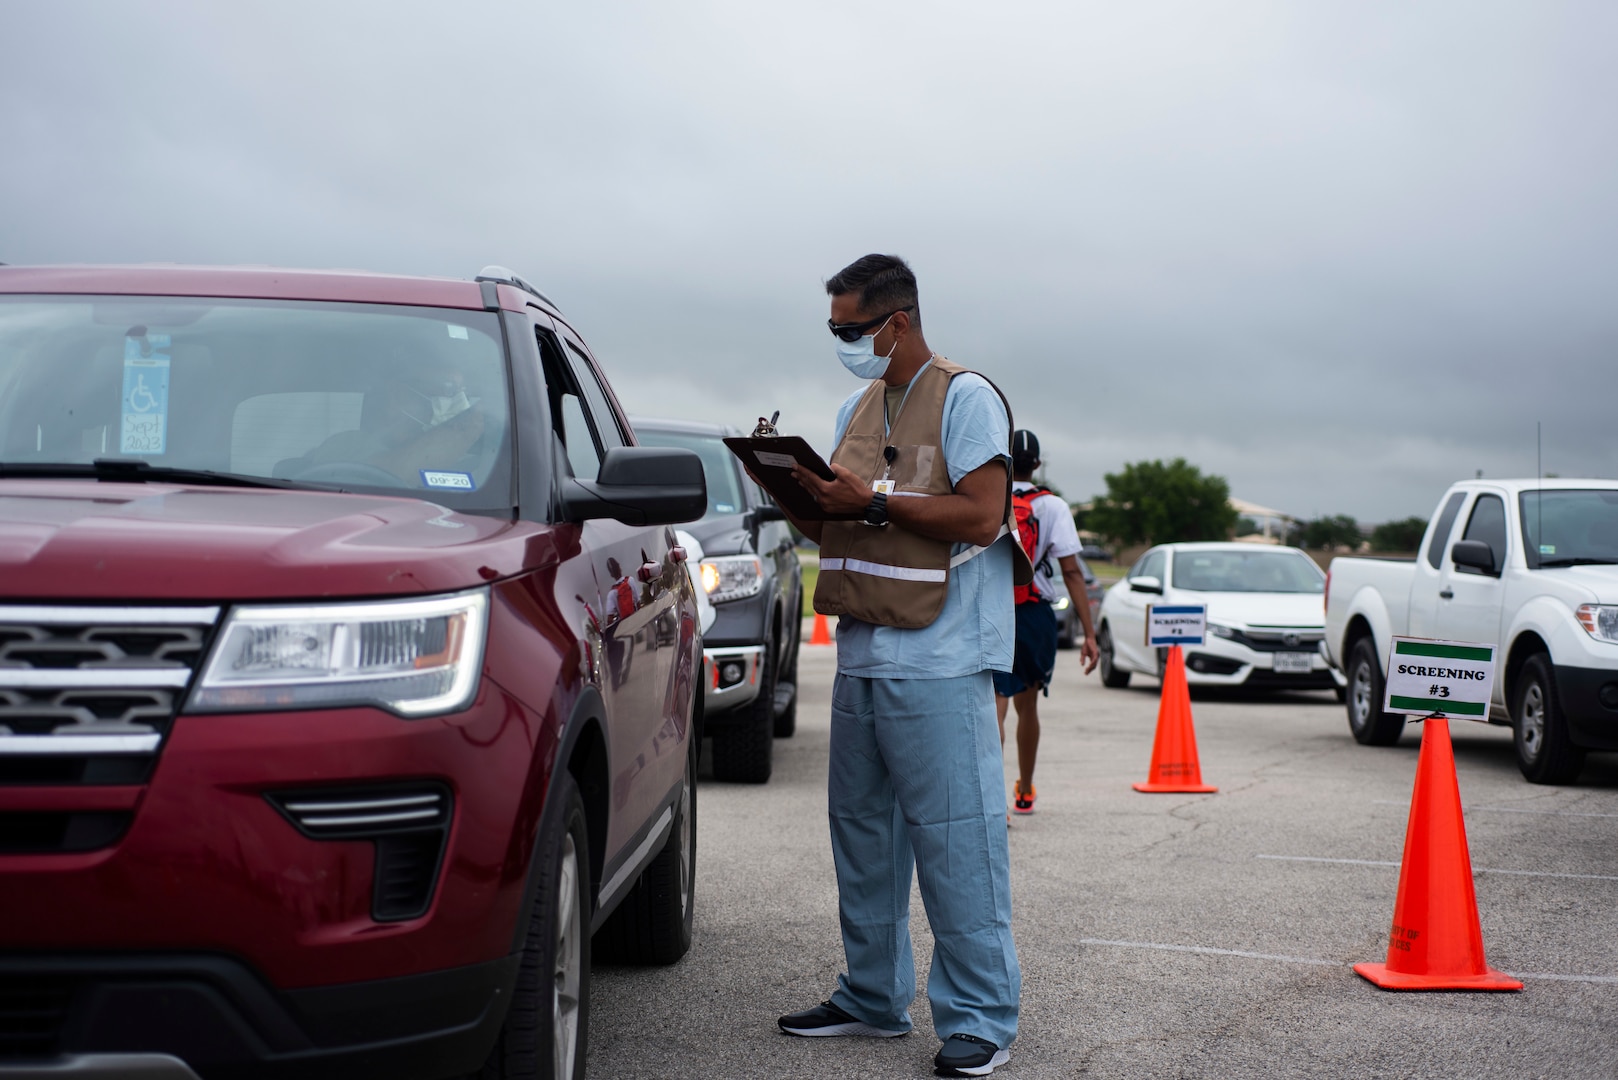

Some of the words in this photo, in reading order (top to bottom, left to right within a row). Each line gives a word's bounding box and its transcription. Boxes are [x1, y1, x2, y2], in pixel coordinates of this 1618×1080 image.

[125, 415, 161, 437] Sept
[1397, 664, 1486, 681] SCREENING
[1429, 684, 1450, 698] #3
[1407, 929, 1420, 940] OF
